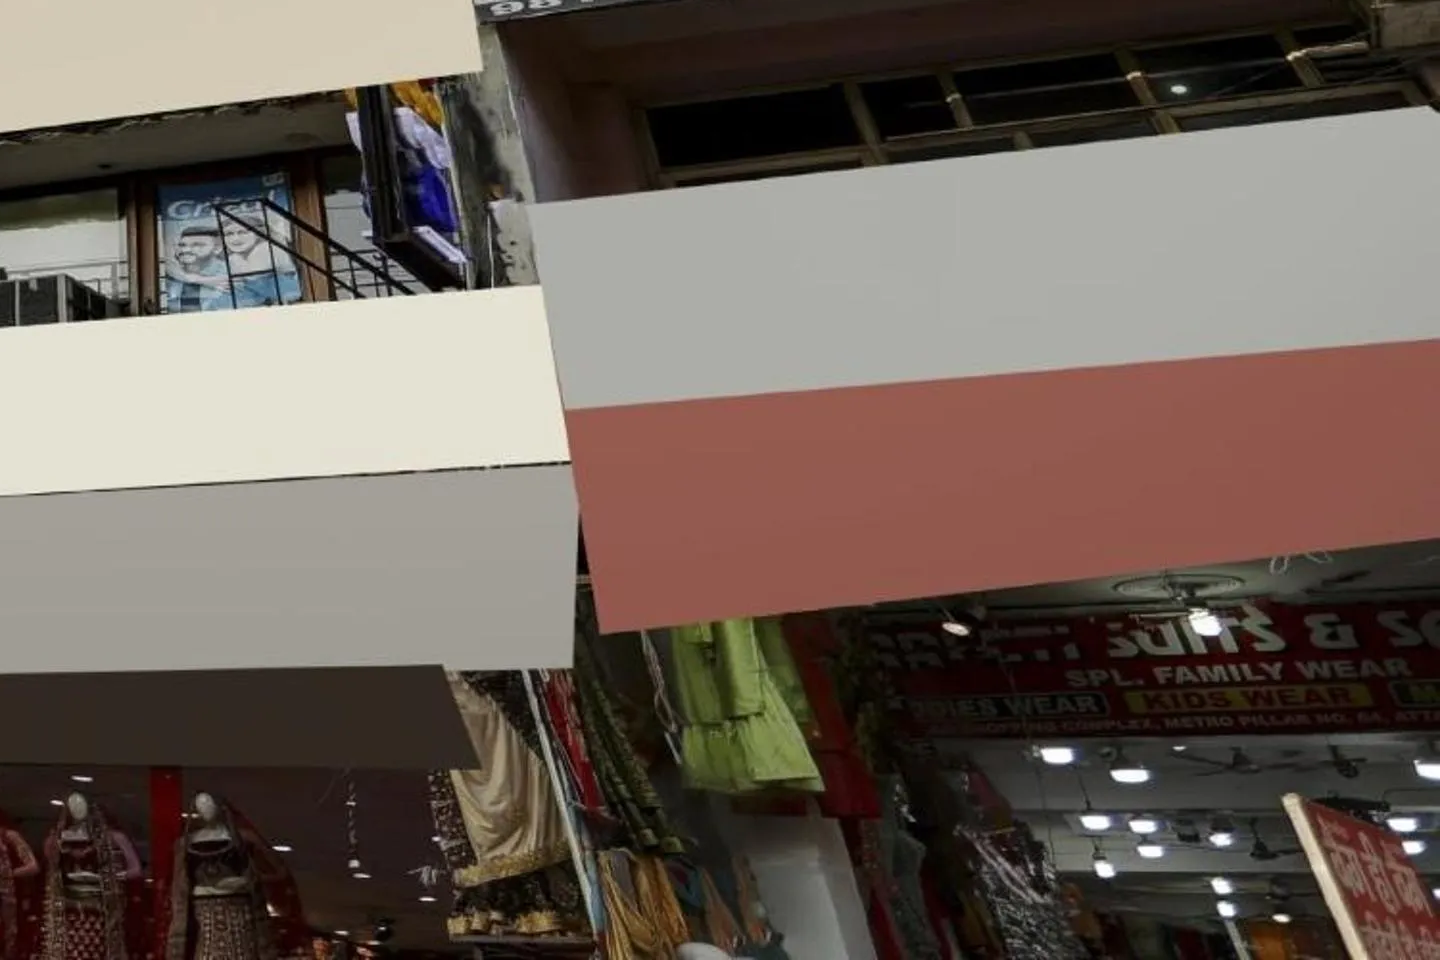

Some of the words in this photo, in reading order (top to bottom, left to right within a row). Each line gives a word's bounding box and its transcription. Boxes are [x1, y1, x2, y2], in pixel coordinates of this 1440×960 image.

[1066, 663, 1146, 689] SPL.
[1158, 660, 1288, 687] FAMILY
[1294, 657, 1413, 681] WEAR
[1002, 695, 1101, 716] WEAR
[1139, 688, 1226, 711] KIDS
[1239, 685, 1354, 709] WEAR
